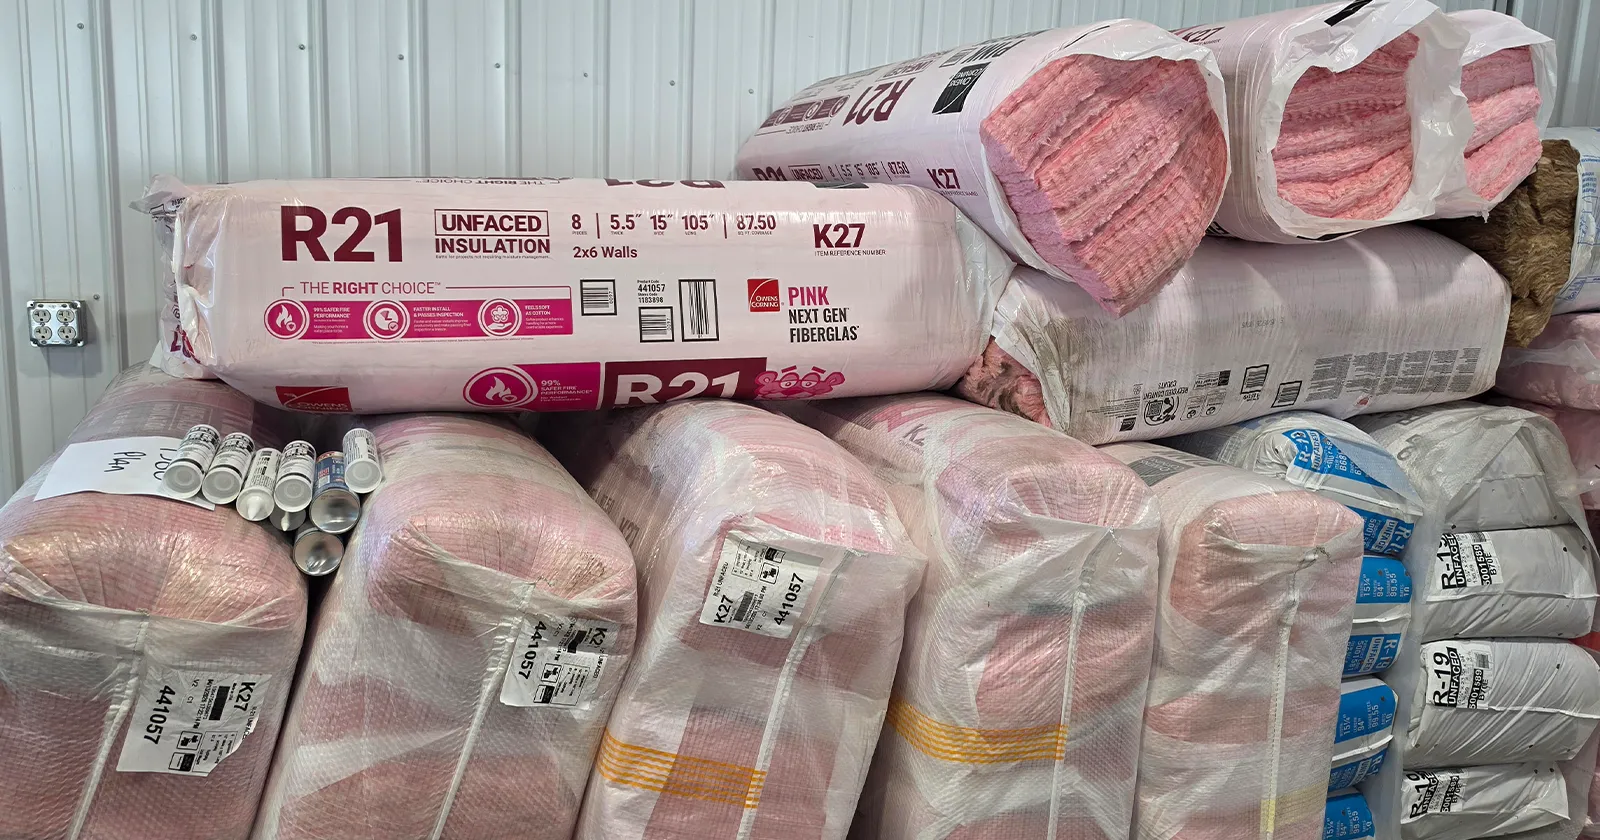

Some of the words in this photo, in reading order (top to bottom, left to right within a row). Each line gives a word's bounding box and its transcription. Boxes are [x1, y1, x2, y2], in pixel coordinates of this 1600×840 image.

[842, 77, 916, 126] R21
[926, 168, 961, 189] K27
[280, 205, 403, 263] R21
[441, 214, 542, 232] UNFACED
[571, 213, 582, 230] 8
[736, 213, 777, 231] 87.50
[435, 238, 551, 254] INSULATION
[813, 223, 866, 248] K27
[573, 246, 598, 258] 2x6
[601, 246, 638, 258] Walls
[300, 281, 329, 294] THE
[333, 282, 379, 295] RIGHT
[637, 283, 666, 293] 441057
[788, 286, 829, 306] PINK
[789, 308, 818, 324] NEXT
[614, 371, 740, 405] R21
[1374, 521, 1396, 552] UNFACE
[714, 594, 734, 624] K27
[773, 572, 804, 626] 441057
[518, 620, 547, 680] 441057
[589, 627, 608, 648] K2
[192, 679, 199, 687] V2
[1433, 652, 1451, 707] R-19
[1448, 651, 1461, 704] UNFACED
[234, 681, 256, 712] K27
[143, 685, 176, 745] 441057
